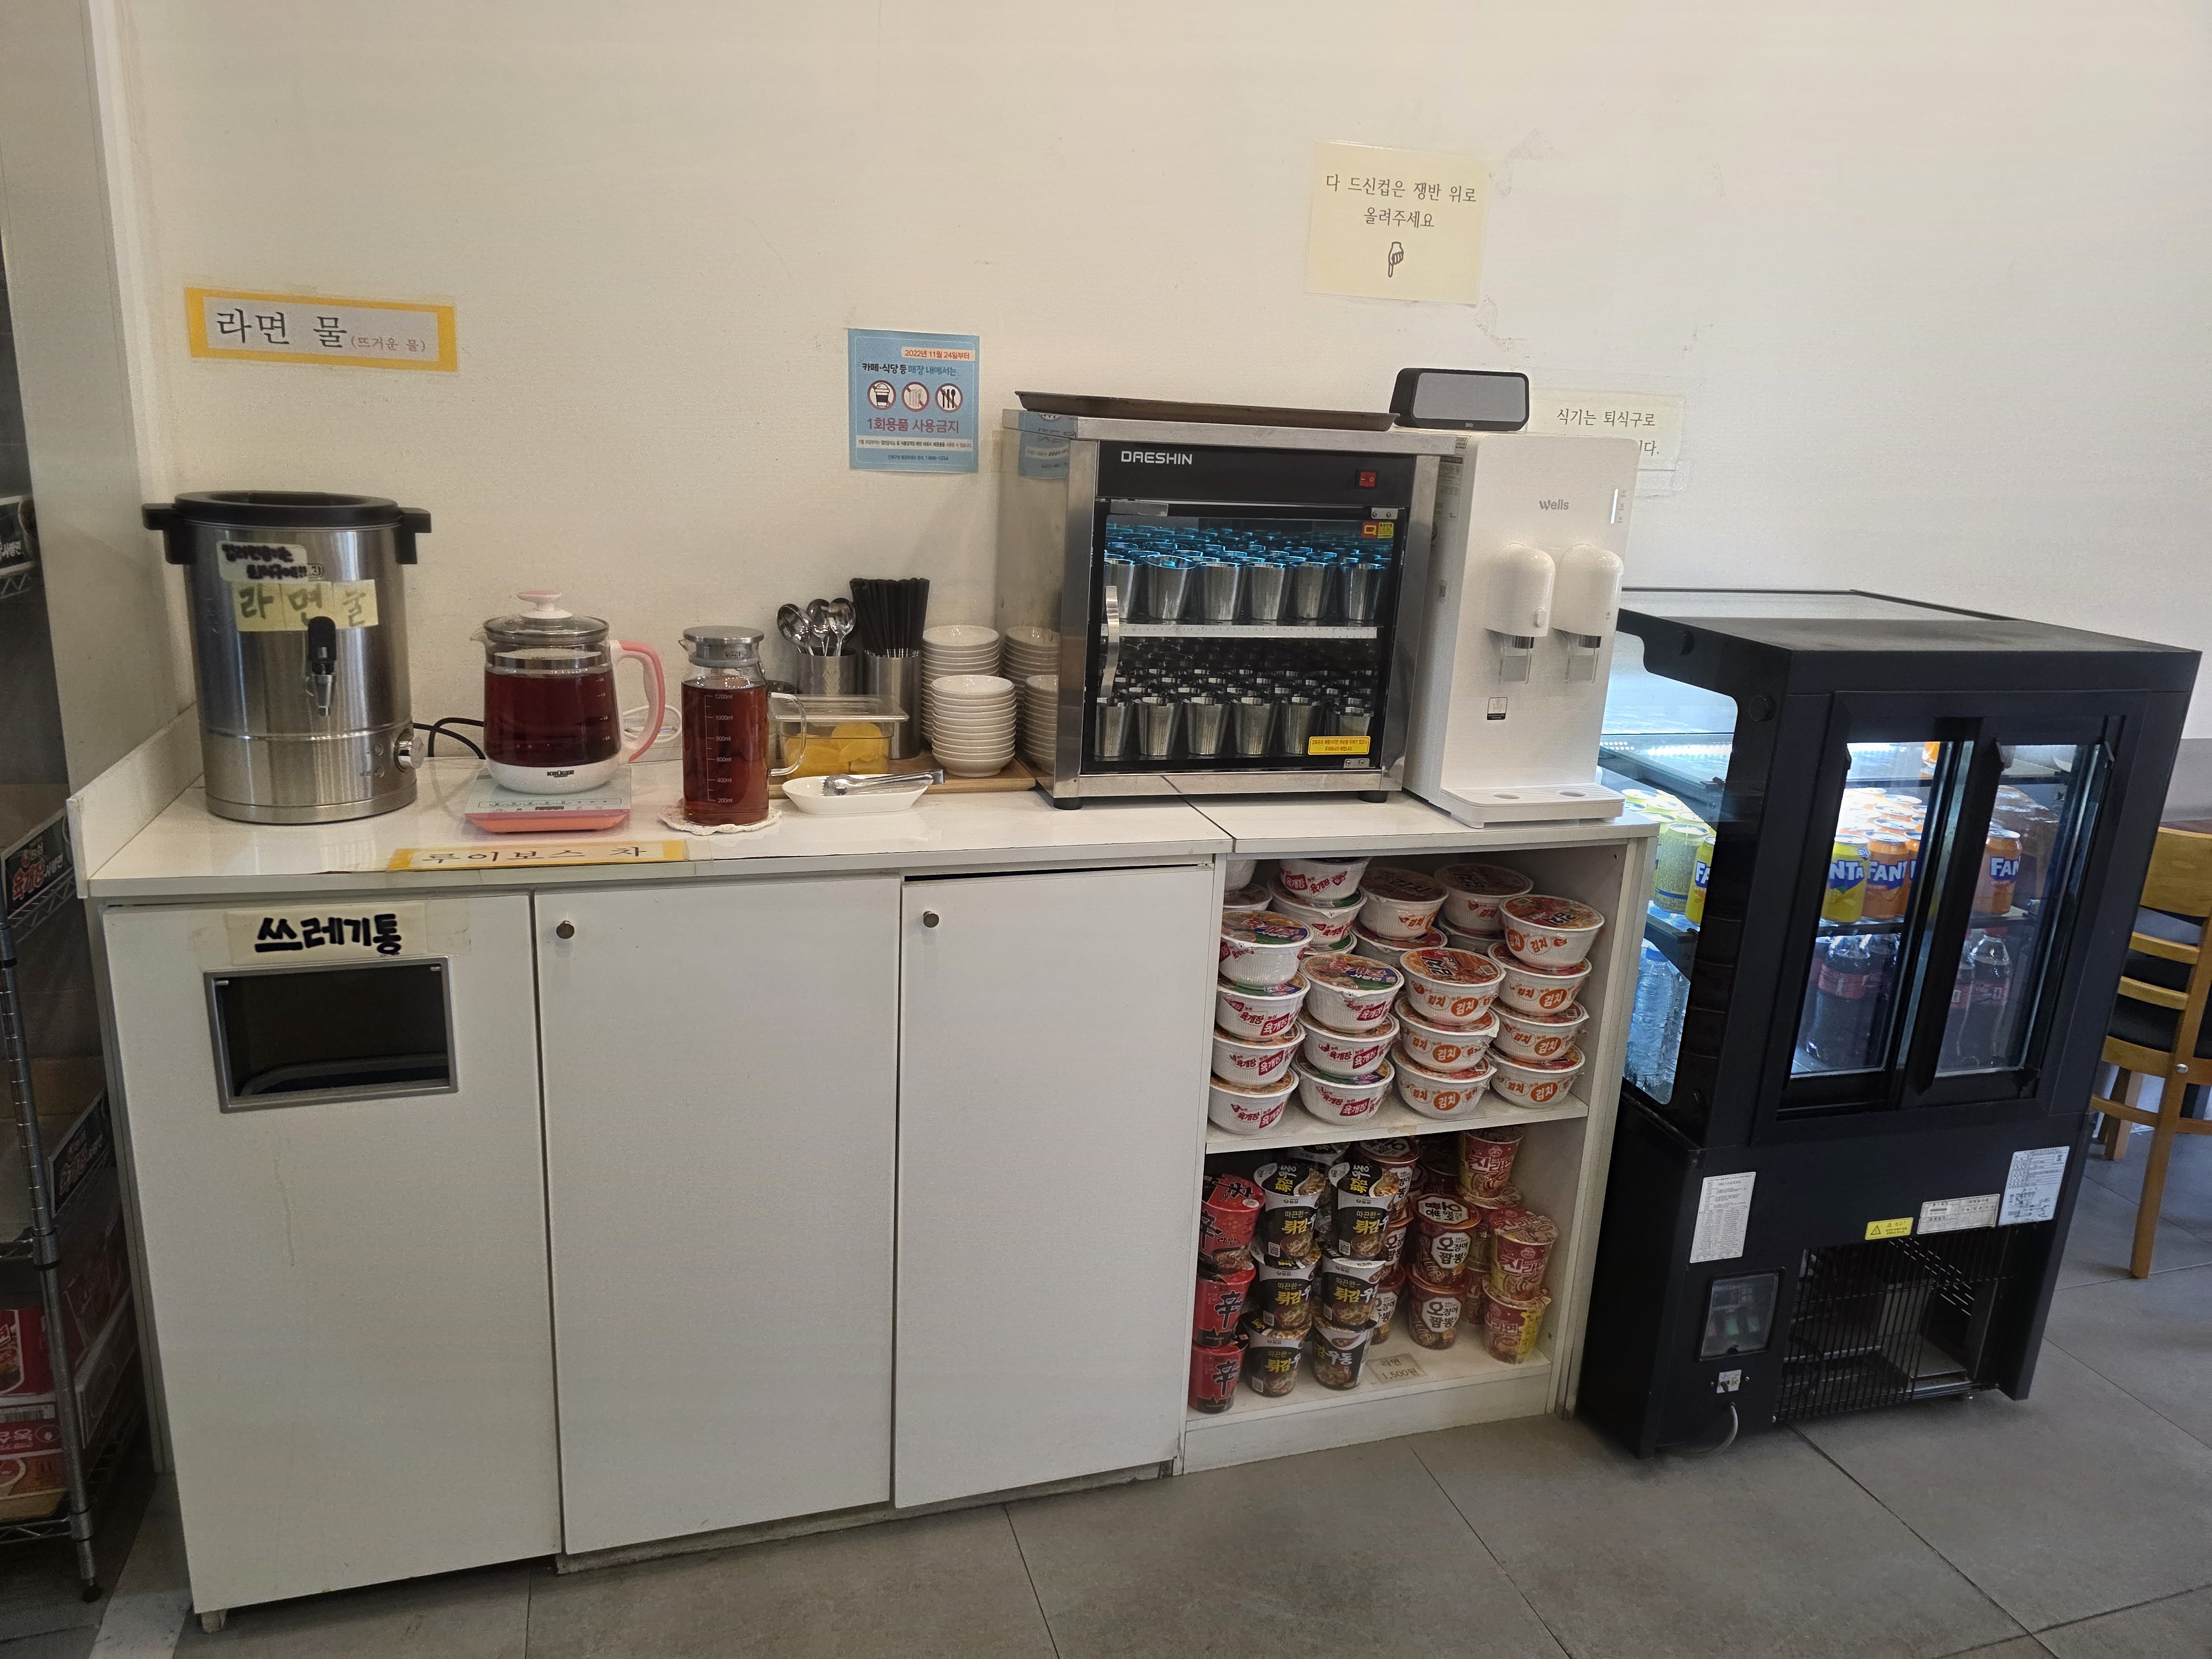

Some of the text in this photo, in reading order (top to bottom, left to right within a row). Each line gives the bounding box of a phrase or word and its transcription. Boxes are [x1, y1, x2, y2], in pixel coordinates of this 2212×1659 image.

[1326, 174, 1477, 203] 다 드신컵은 쟁반 위로
[1363, 207, 1434, 228] 올려주세요
[217, 308, 425, 352] 라면 물 (뜨거운 물)
[905, 349, 969, 360] 2022년 11월 24일부터
[900, 365, 907, 375] 등
[908, 366, 924, 375] 매장
[926, 367, 957, 377] 내에서는
[867, 418, 959, 434] 1회용품 사용금지
[1557, 409, 1656, 429] 식기는 퇴식구로
[1121, 450, 1193, 465] DAESHIN
[1539, 499, 1569, 510] Wells
[421, 846, 647, 864] 루이보스 차
[1828, 860, 1864, 880] NTA
[1286, 877, 1305, 889] 육개장
[1310, 878, 1331, 894] 육개장
[1408, 916, 1426, 927] 김치
[254, 912, 402, 955] 쓰레기통
[1530, 937, 1548, 953] 김치
[1517, 988, 1535, 999] 김치
[1544, 990, 1563, 1007] 김치
[1428, 995, 1447, 1008] 김치
[1456, 999, 1475, 1015] 김치
[1239, 1012, 1264, 1025] 육개장
[1360, 1005, 1384, 1020] 육개장
[1263, 1018, 1288, 1034] 육개장
[1412, 1037, 1428, 1051] 김치
[1514, 1032, 1533, 1044] 김치
[1437, 1047, 1457, 1061] 김치
[1538, 1039, 1559, 1055] 김치
[1237, 1058, 1257, 1068] 육개장
[1260, 1054, 1282, 1072] 육개장
[1329, 1051, 1352, 1060] 육개장
[1355, 1050, 1378, 1066] 육개장
[1412, 1089, 1427, 1100] 김치
[1508, 1082, 1525, 1094] 김치
[1536, 1083, 1554, 1101] 김치
[1323, 1094, 1344, 1106] 육개장
[1438, 1093, 1456, 1109] 김치
[1342, 1101, 1367, 1115] 육개장
[1238, 1112, 1260, 1121] 육개장
[1261, 1106, 1282, 1126] 육개장
[1437, 1237, 1468, 1252] 오징어
[1439, 1252, 1464, 1265] 짬뽕
[1427, 1301, 1459, 1317] 오징어
[1429, 1316, 1455, 1329] 짬뽕
[1381, 1357, 1401, 1367] 라면
[1381, 1368, 1420, 1380] 1,500원
